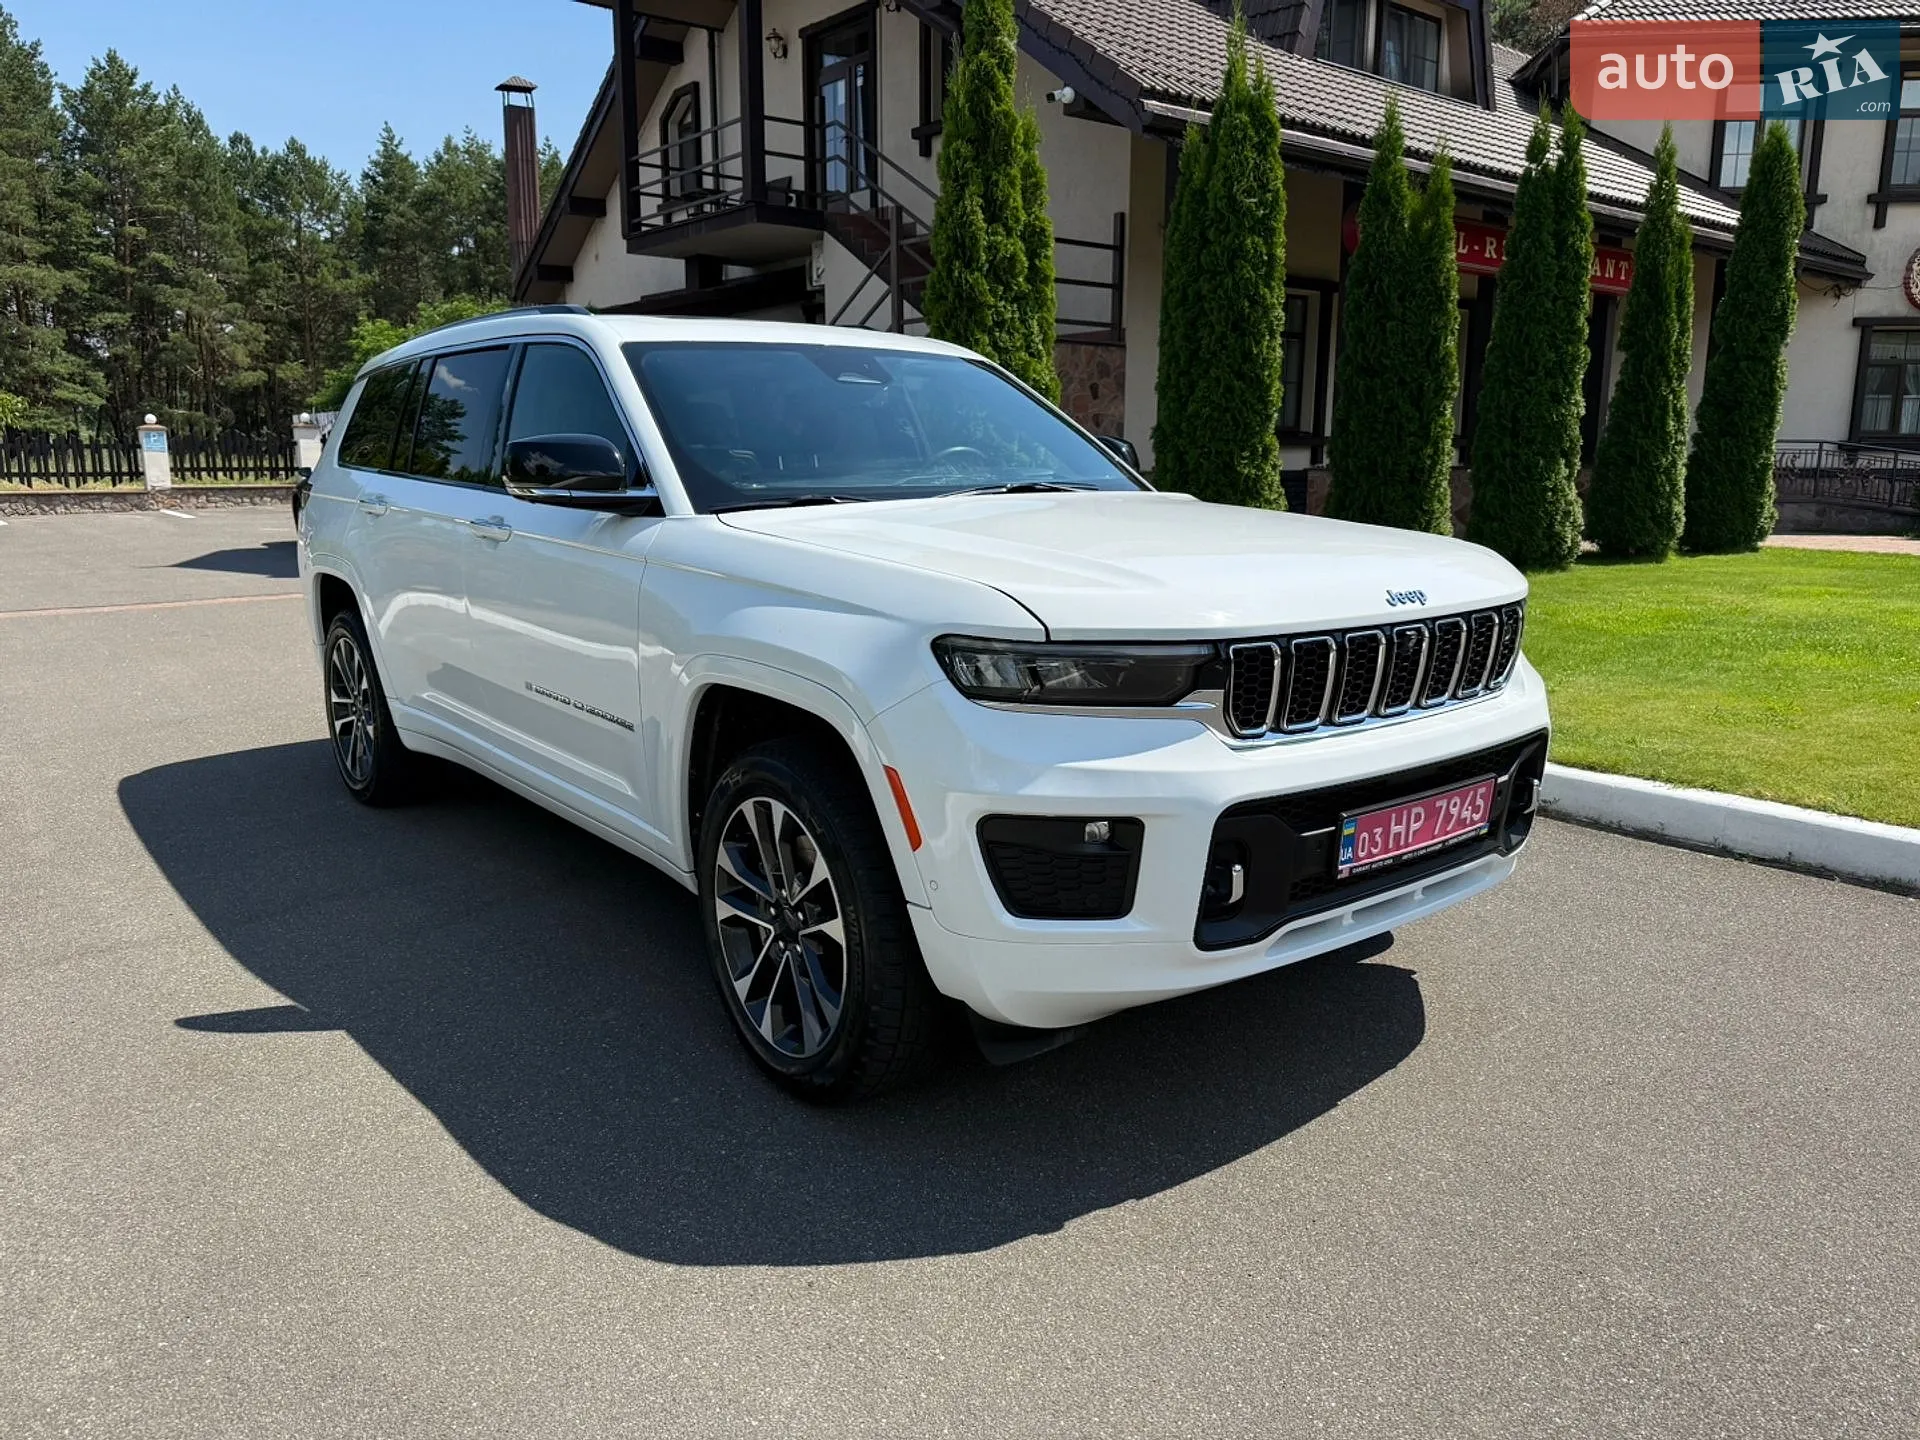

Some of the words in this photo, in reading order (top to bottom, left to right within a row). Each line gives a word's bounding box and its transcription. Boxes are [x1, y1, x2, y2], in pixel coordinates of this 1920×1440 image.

[1385, 589, 1427, 607] Jeep
[1358, 826, 1384, 858] 03
[1434, 787, 1487, 836] 7945
[1341, 846, 1354, 861] UA
